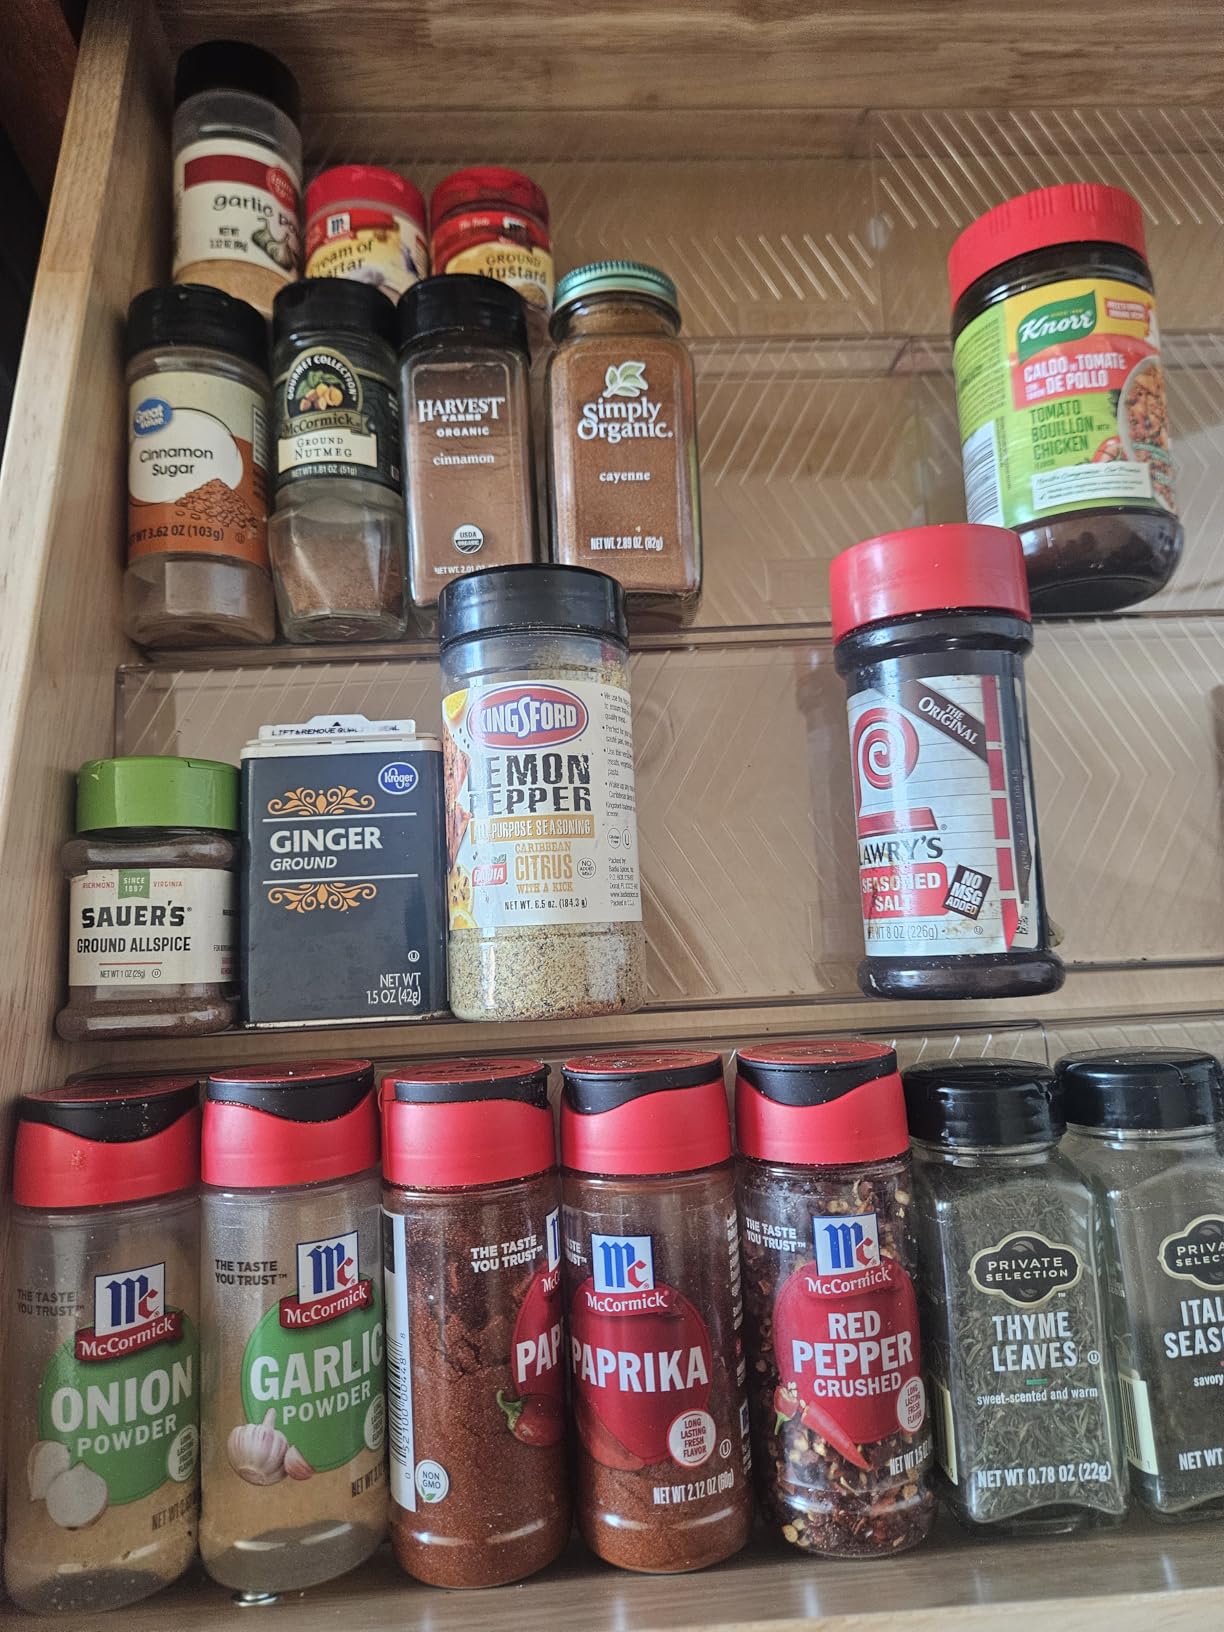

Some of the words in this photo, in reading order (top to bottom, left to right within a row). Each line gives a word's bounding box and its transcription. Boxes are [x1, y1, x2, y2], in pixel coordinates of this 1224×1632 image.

[212, 193, 273, 217] garlic
[1018, 310, 1094, 344] Knorr
[1023, 356, 1069, 384] CALDO
[1075, 352, 1128, 370] TOMATE
[1045, 375, 1065, 396] DE
[1066, 369, 1109, 391] POLLO
[417, 396, 506, 423] HARVEST
[582, 396, 662, 425] Simply
[1030, 399, 1081, 425] TOMATO
[281, 413, 353, 436] McCormick
[436, 426, 490, 438] ORGANIC
[1031, 415, 1095, 444] BOUILLON
[139, 447, 214, 464] Cinnamon
[1033, 434, 1089, 461] CHICKEN
[432, 452, 496, 466] cinnamon
[151, 463, 195, 478] Sugar
[599, 471, 651, 485] cayenne
[171, 524, 186, 536] OZ
[187, 525, 225, 541] (103g)
[481, 696, 577, 738] KINGSFORD
[917, 696, 980, 746] ORIGINAL
[945, 703, 966, 722] THE
[384, 767, 414, 789] Kroger
[535, 818, 591, 837] SEASONING
[269, 826, 384, 854] GINGER
[514, 841, 572, 854] CARIBBEAN
[859, 835, 944, 866] AWRY'S
[269, 856, 338, 872] GROUND
[515, 853, 574, 881] CITRUS
[123, 876, 145, 885] SINCE
[153, 880, 183, 888] VIRGINIA
[516, 883, 540, 895] WITH
[543, 882, 550, 893] A
[552, 881, 574, 893] KICK
[961, 870, 983, 891] NO
[949, 882, 984, 906] MSG
[81, 900, 185, 929] SAUER'S
[504, 900, 518, 911] NET
[519, 900, 533, 911] WT.
[943, 897, 978, 917] ADDED
[893, 925, 905, 939] OZ
[907, 923, 938, 940] (226g)
[76, 937, 126, 953] GROUND
[129, 936, 192, 953] ALLSPICE
[100, 970, 110, 979] NET
[379, 973, 401, 988] NET
[402, 972, 421, 987] WT
[366, 990, 379, 1005] 1.5
[380, 990, 397, 1004] OZ
[398, 986, 422, 1006] (42g)
[745, 1216, 760, 1232] THE
[762, 1221, 797, 1240] TASTE
[746, 1229, 762, 1246] YOU
[470, 1245, 498, 1260] THE
[501, 1234, 537, 1255] TASTE
[215, 1259, 234, 1272] THE
[237, 1260, 278, 1273] TASTE
[470, 1258, 500, 1274] YOU
[988, 1256, 1063, 1271] PRIVATE
[215, 1272, 234, 1286] YOU
[804, 1266, 893, 1296] McCormick
[985, 1268, 1069, 1282] SELECTION
[16, 1288, 34, 1302] THE
[36, 1290, 75, 1303] TASTE
[284, 1284, 368, 1324] McCormick
[585, 1291, 668, 1313] McCormick
[17, 1302, 34, 1316] YOU
[827, 1310, 882, 1341] RED
[991, 1310, 1073, 1342] THYME
[79, 1318, 175, 1357] McCormick
[250, 1321, 383, 1402] GARLIC
[571, 1335, 710, 1393] PAPRIKA
[791, 1330, 914, 1378] PEPPER
[991, 1340, 1079, 1373] LEAVES
[813, 1371, 902, 1398] CRUSHED
[907, 1383, 919, 1397] LONG
[1193, 1373, 1224, 1388] savory
[51, 1354, 193, 1434] ONION
[282, 1379, 371, 1425] POWDER
[905, 1391, 921, 1407] LASTING
[976, 1388, 1048, 1406] sweet-scented
[1050, 1386, 1069, 1401] and
[1070, 1386, 1099, 1399] warm
[908, 1402, 920, 1416] FRESH
[680, 1425, 707, 1440] LASTING
[684, 1417, 702, 1430] LONG
[76, 1413, 177, 1458] POWDER
[684, 1436, 705, 1450] FRESH
[683, 1445, 708, 1459] FLAVOR
[1178, 1452, 1203, 1471] NET
[1203, 1448, 1224, 1467] WT
[889, 1456, 903, 1476] NET
[903, 1450, 914, 1470] WT
[422, 1470, 440, 1480] NON
[422, 1479, 441, 1490] GMO
[976, 1469, 1001, 1488] NET
[1004, 1467, 1026, 1486] WT
[1027, 1465, 1054, 1484] 0.78
[1057, 1463, 1076, 1483] OZ
[1078, 1461, 1112, 1483] (22g)
[652, 1486, 671, 1505] NET
[671, 1484, 687, 1503] WT
[687, 1480, 706, 1501] 2.12
[706, 1475, 718, 1496] OZ
